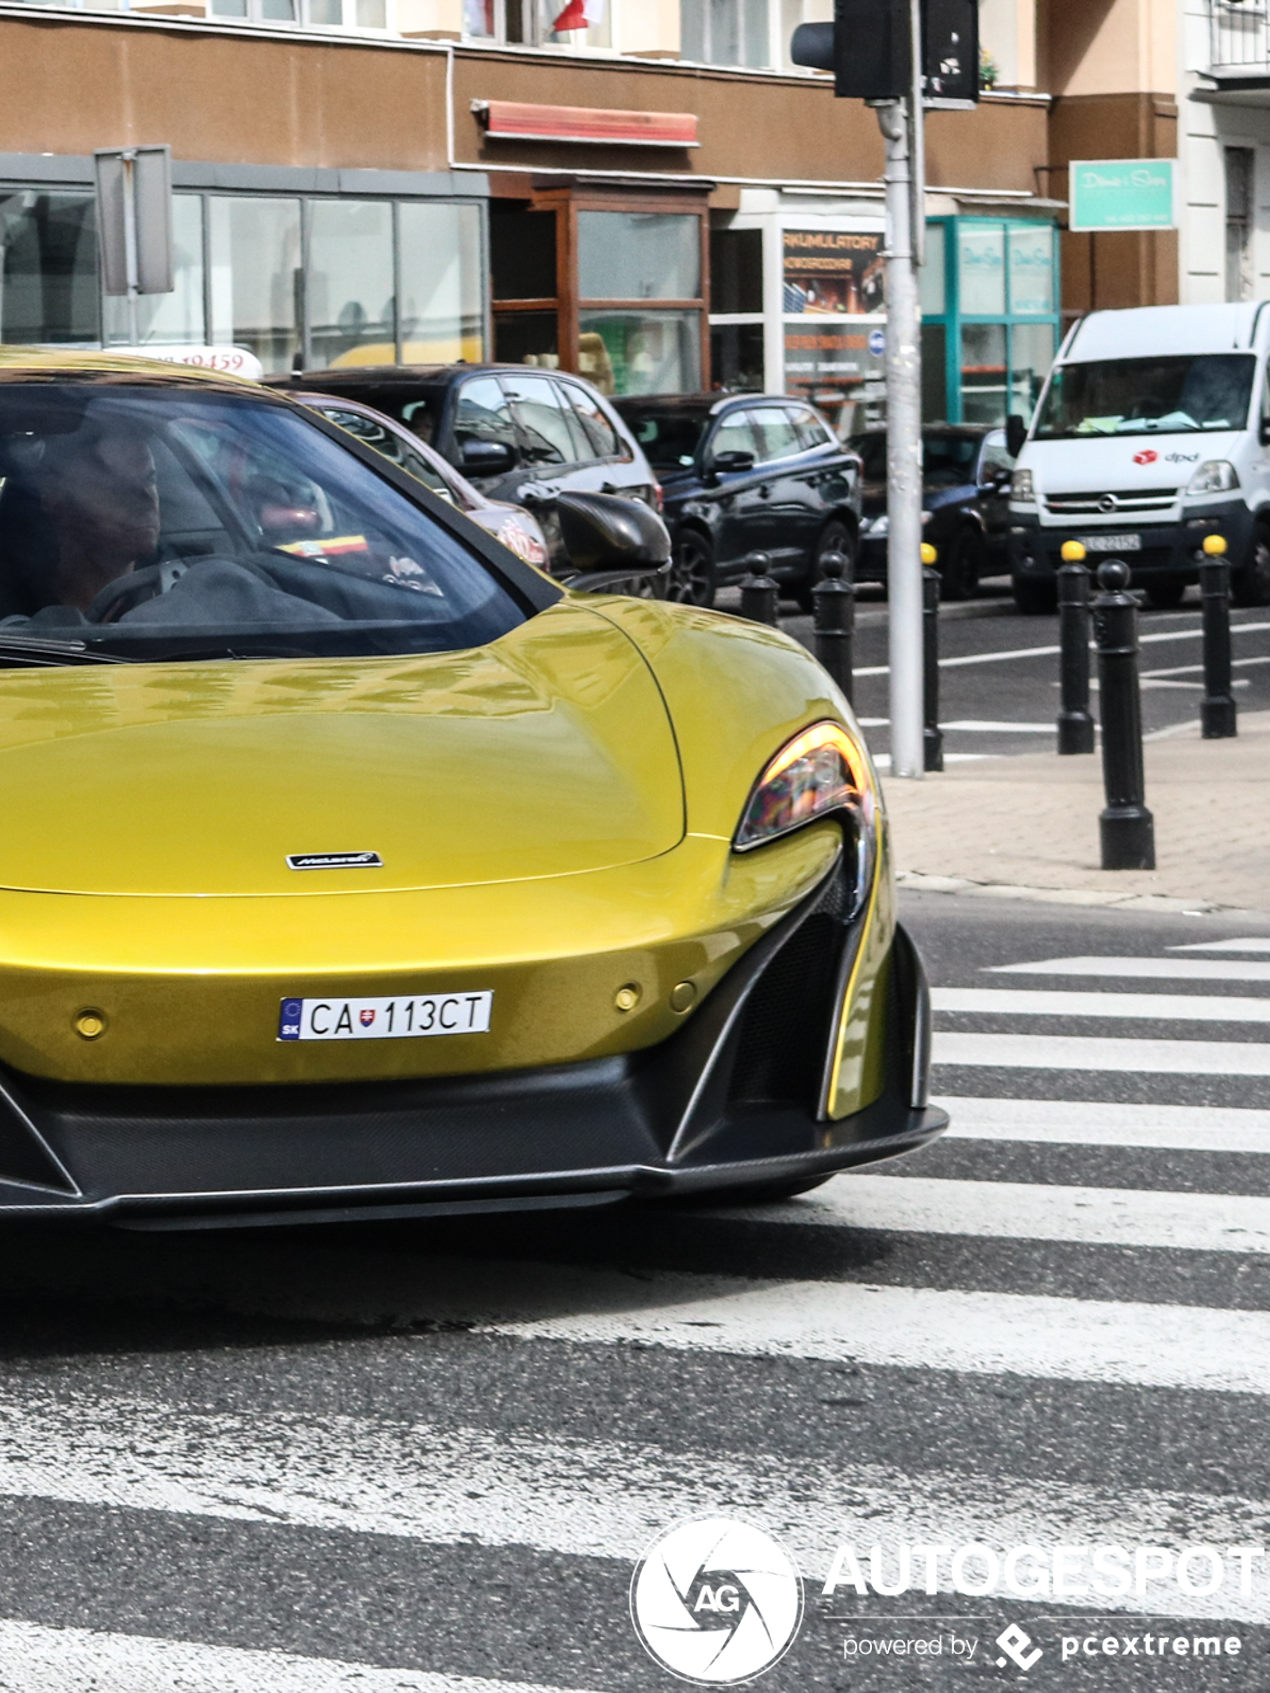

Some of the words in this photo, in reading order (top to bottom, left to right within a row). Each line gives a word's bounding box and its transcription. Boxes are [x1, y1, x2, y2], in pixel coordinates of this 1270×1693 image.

[783, 233, 879, 250] AKUMULATORY
[1165, 451, 1200, 464] dpd
[296, 854, 370, 866] McLaren
[282, 1025, 299, 1035] SK
[310, 1003, 353, 1035] CA
[385, 996, 483, 1033] 113CT
